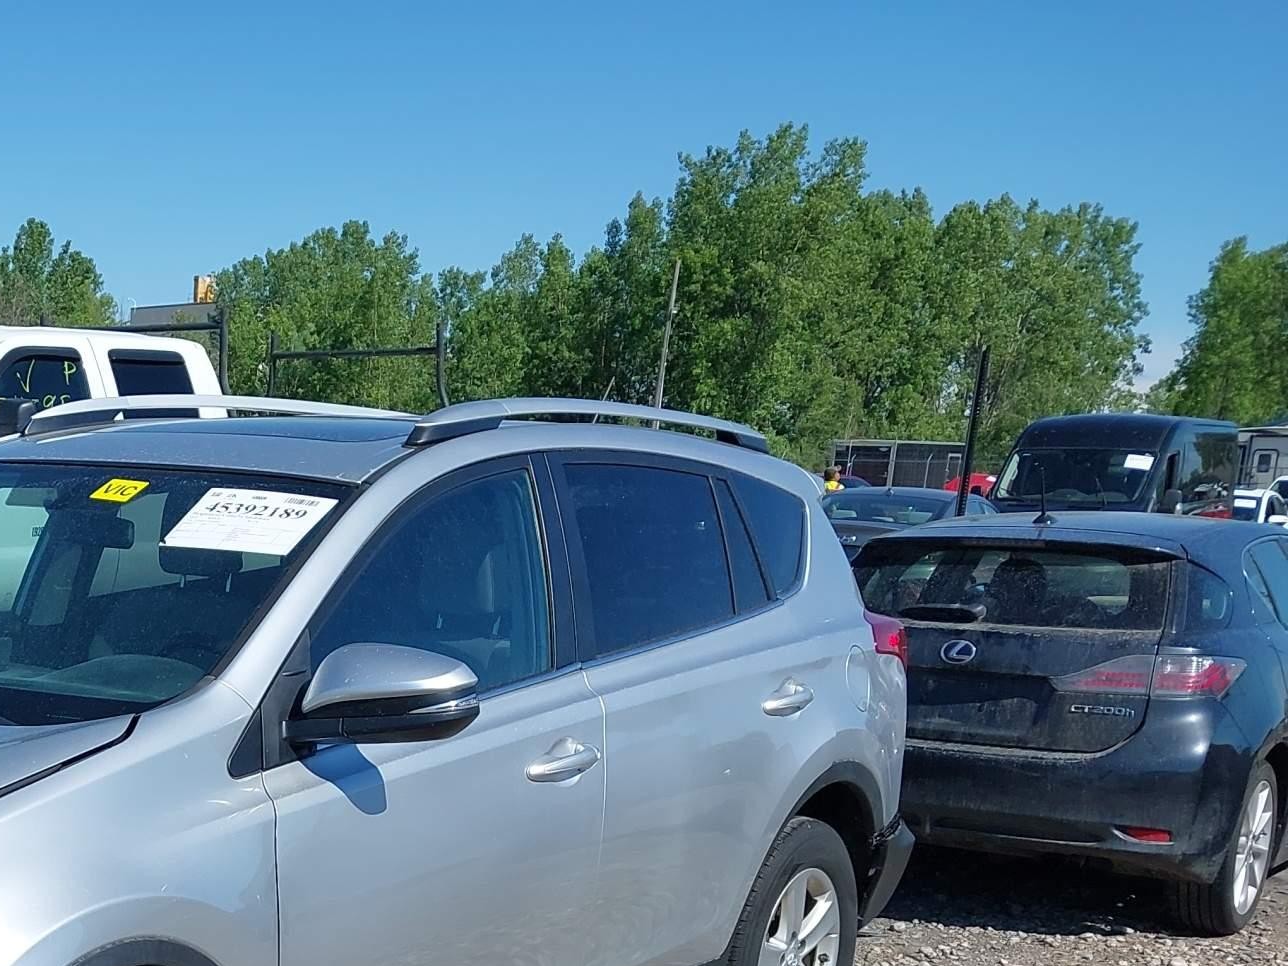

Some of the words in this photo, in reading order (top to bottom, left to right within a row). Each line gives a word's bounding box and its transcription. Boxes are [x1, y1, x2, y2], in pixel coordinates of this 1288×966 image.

[63, 361, 77, 386] P
[104, 484, 138, 496] VIC
[205, 501, 308, 519] 45392189
[1071, 704, 1135, 719] CT200h
